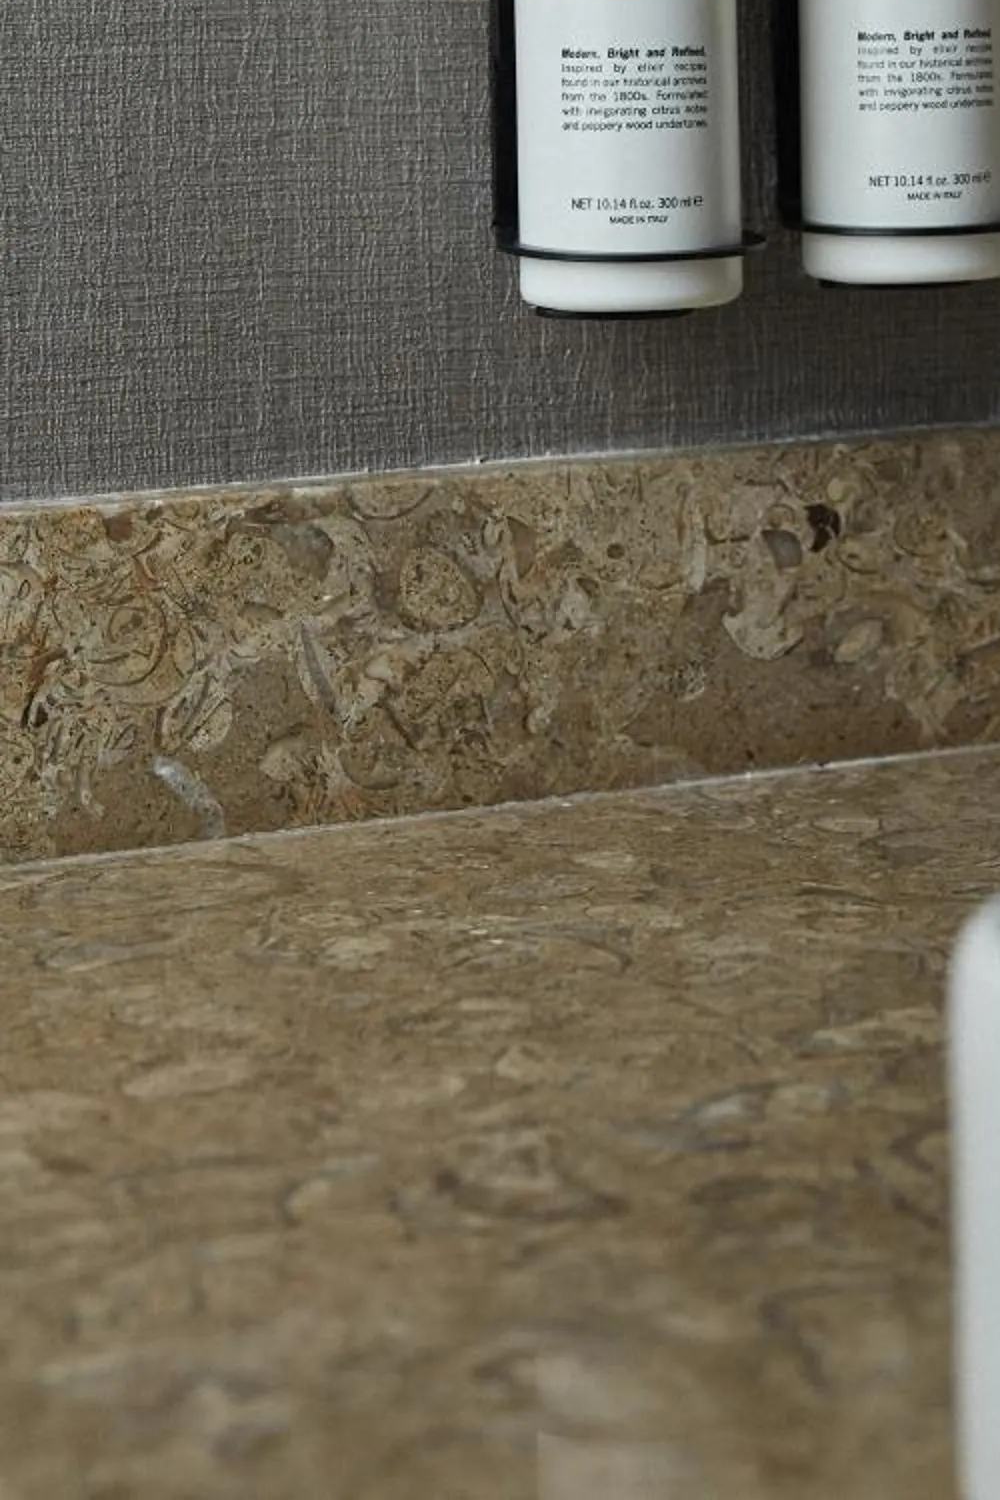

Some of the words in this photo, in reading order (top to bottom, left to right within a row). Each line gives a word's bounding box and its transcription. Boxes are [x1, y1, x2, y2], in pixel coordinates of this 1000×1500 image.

[910, 45, 923, 56] by
[613, 63, 627, 74] by
[879, 101, 919, 111] peppery
[922, 100, 948, 109] wood
[581, 121, 623, 132] peppery
[625, 120, 652, 130] wood
[869, 176, 889, 187] NET
[907, 192, 930, 200] MADE
[943, 191, 962, 199] ITALY
[571, 198, 592, 210] NET
[596, 197, 627, 210] 10.14
[658, 196, 679, 208] 300
[609, 215, 634, 224] MADE
[647, 215, 669, 223] ITALY
